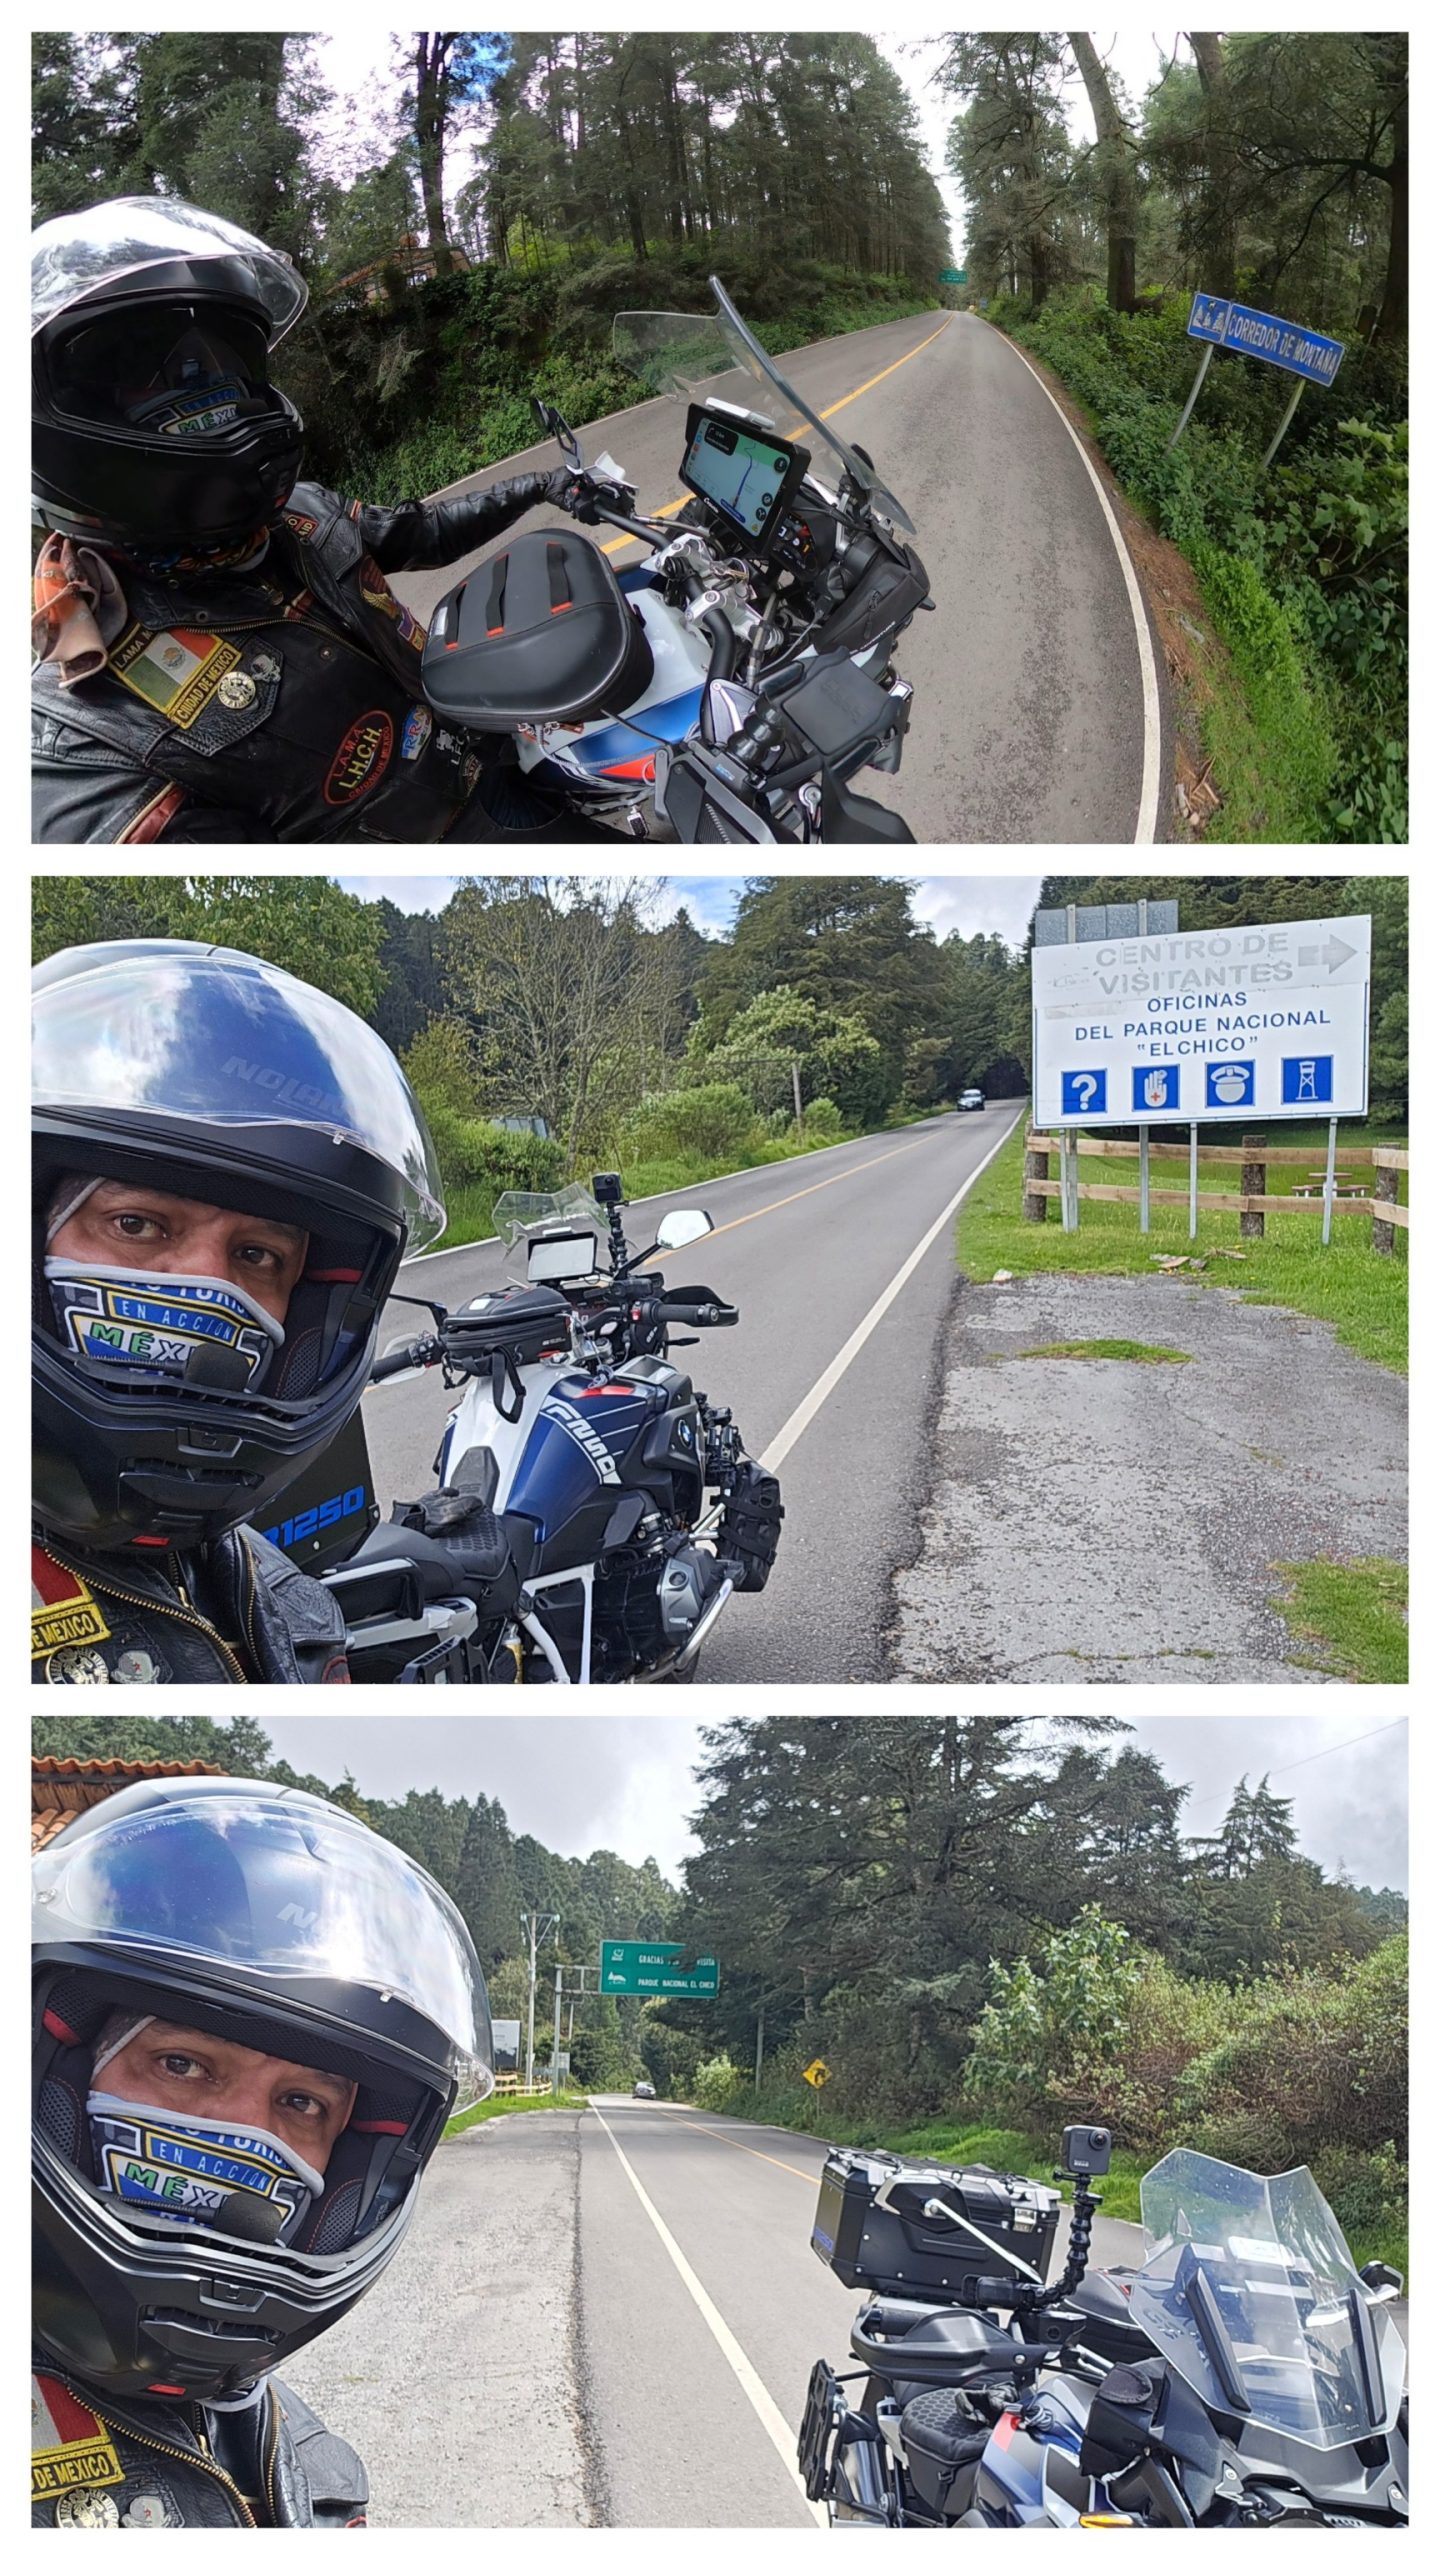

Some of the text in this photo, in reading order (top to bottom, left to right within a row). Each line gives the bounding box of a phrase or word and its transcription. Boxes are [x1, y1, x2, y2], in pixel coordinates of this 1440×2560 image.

[1228, 314, 1338, 376] CORREDOR DE MONTAÑA
[114, 640, 146, 669] LAMA
[177, 650, 234, 720] CIUDAD DE MEXICO
[338, 726, 383, 790] L.H.C.H.
[1095, 932, 1290, 968] CENTRO DE
[1099, 960, 1294, 996] VISITANTES
[1147, 991, 1248, 1013] OFICINAS
[1075, 1009, 1331, 1041] DEL PARQUE NACIONAL
[121, 1299, 147, 1320] EN
[38, 1612, 96, 1646] MEXICO
[159, 2142, 184, 2163] EN
[33, 2466, 57, 2489] DE
[53, 2454, 111, 2485] MEXICO
